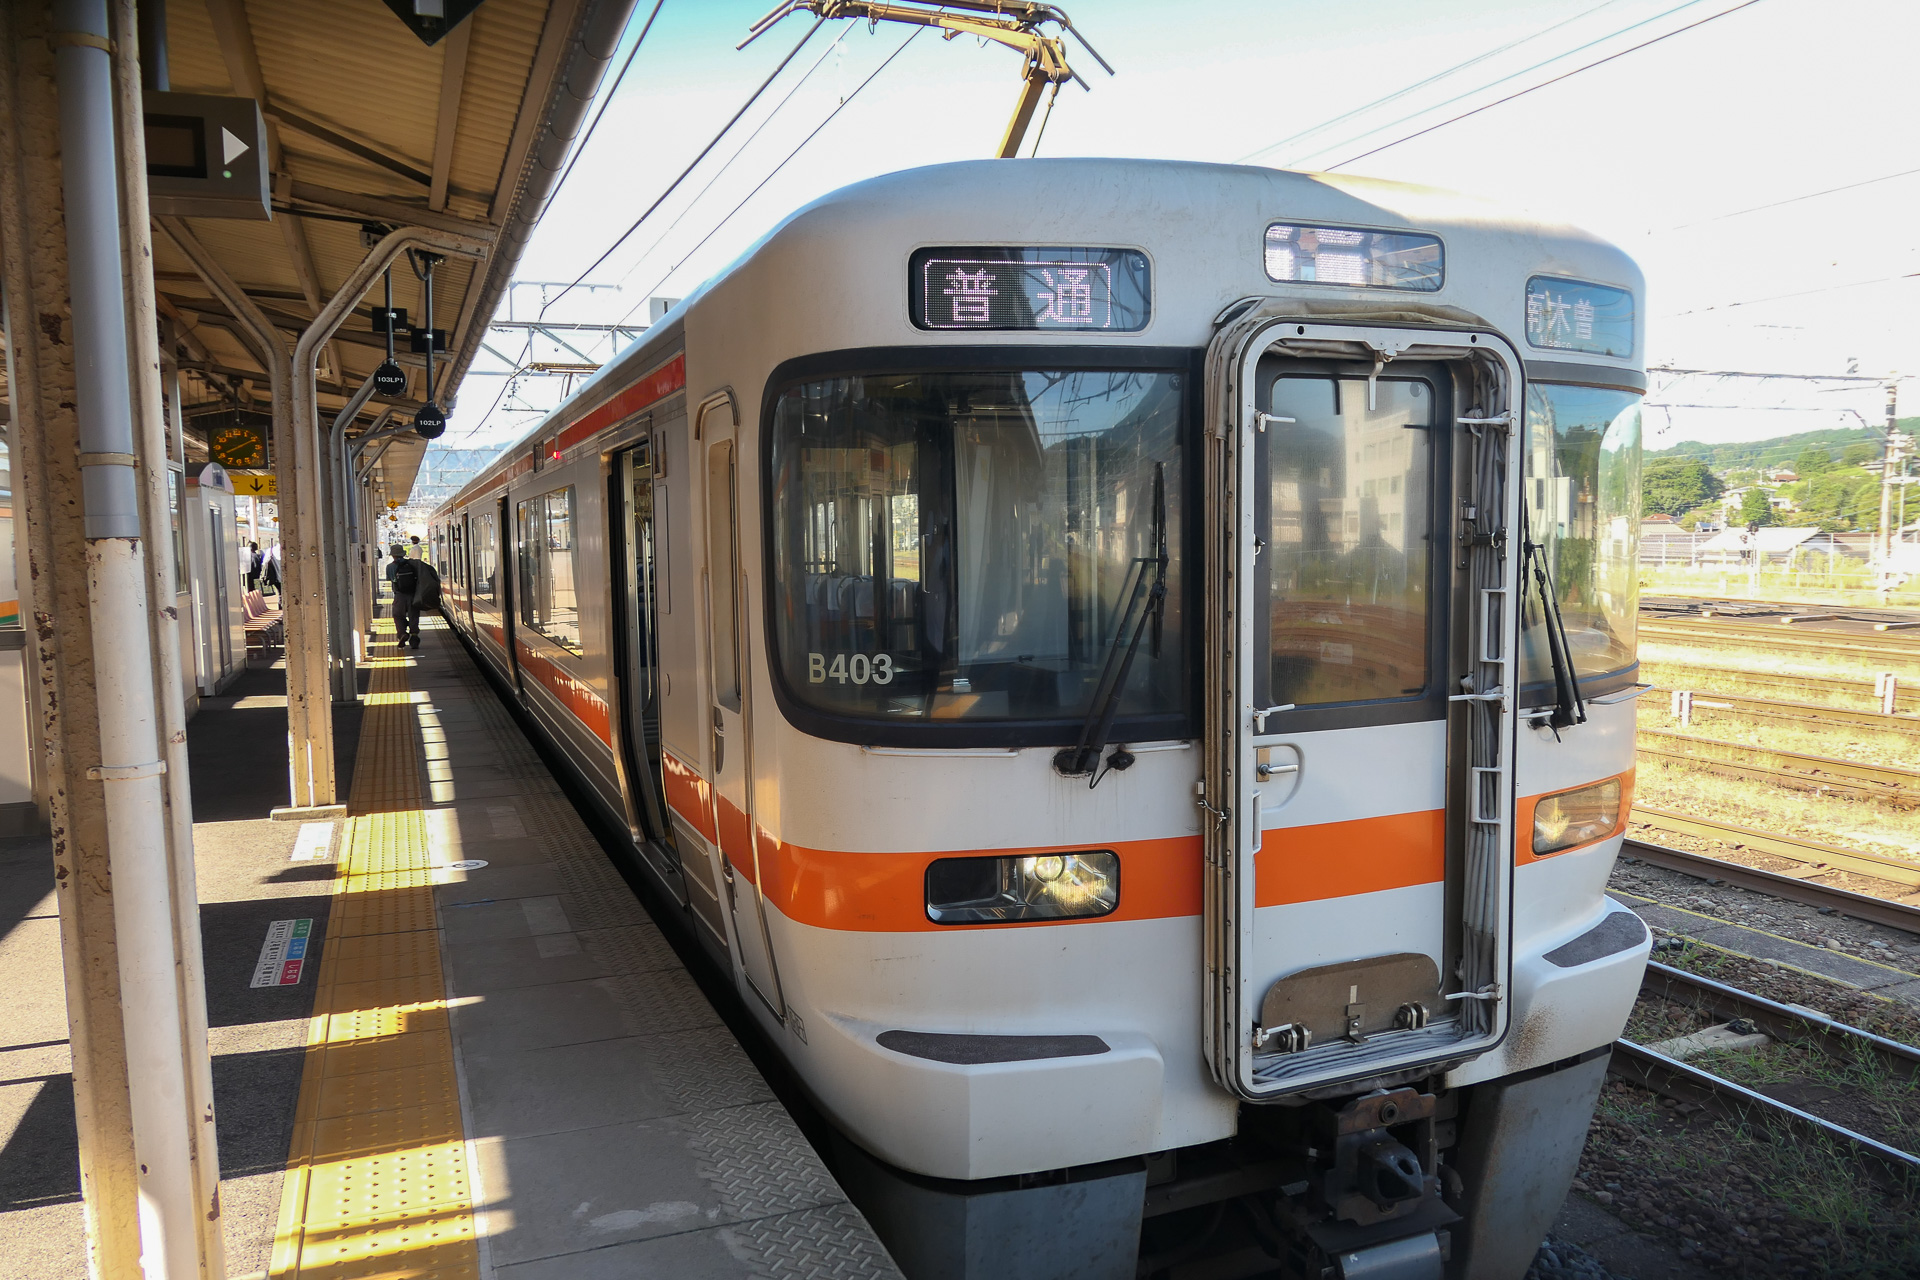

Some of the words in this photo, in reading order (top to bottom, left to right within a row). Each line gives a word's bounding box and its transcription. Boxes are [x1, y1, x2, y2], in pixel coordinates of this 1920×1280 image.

[944, 267, 1093, 324] 普通
[377, 375, 404, 384] 103LP1
[419, 419, 442, 427] 102LP
[808, 652, 894, 685] B403
